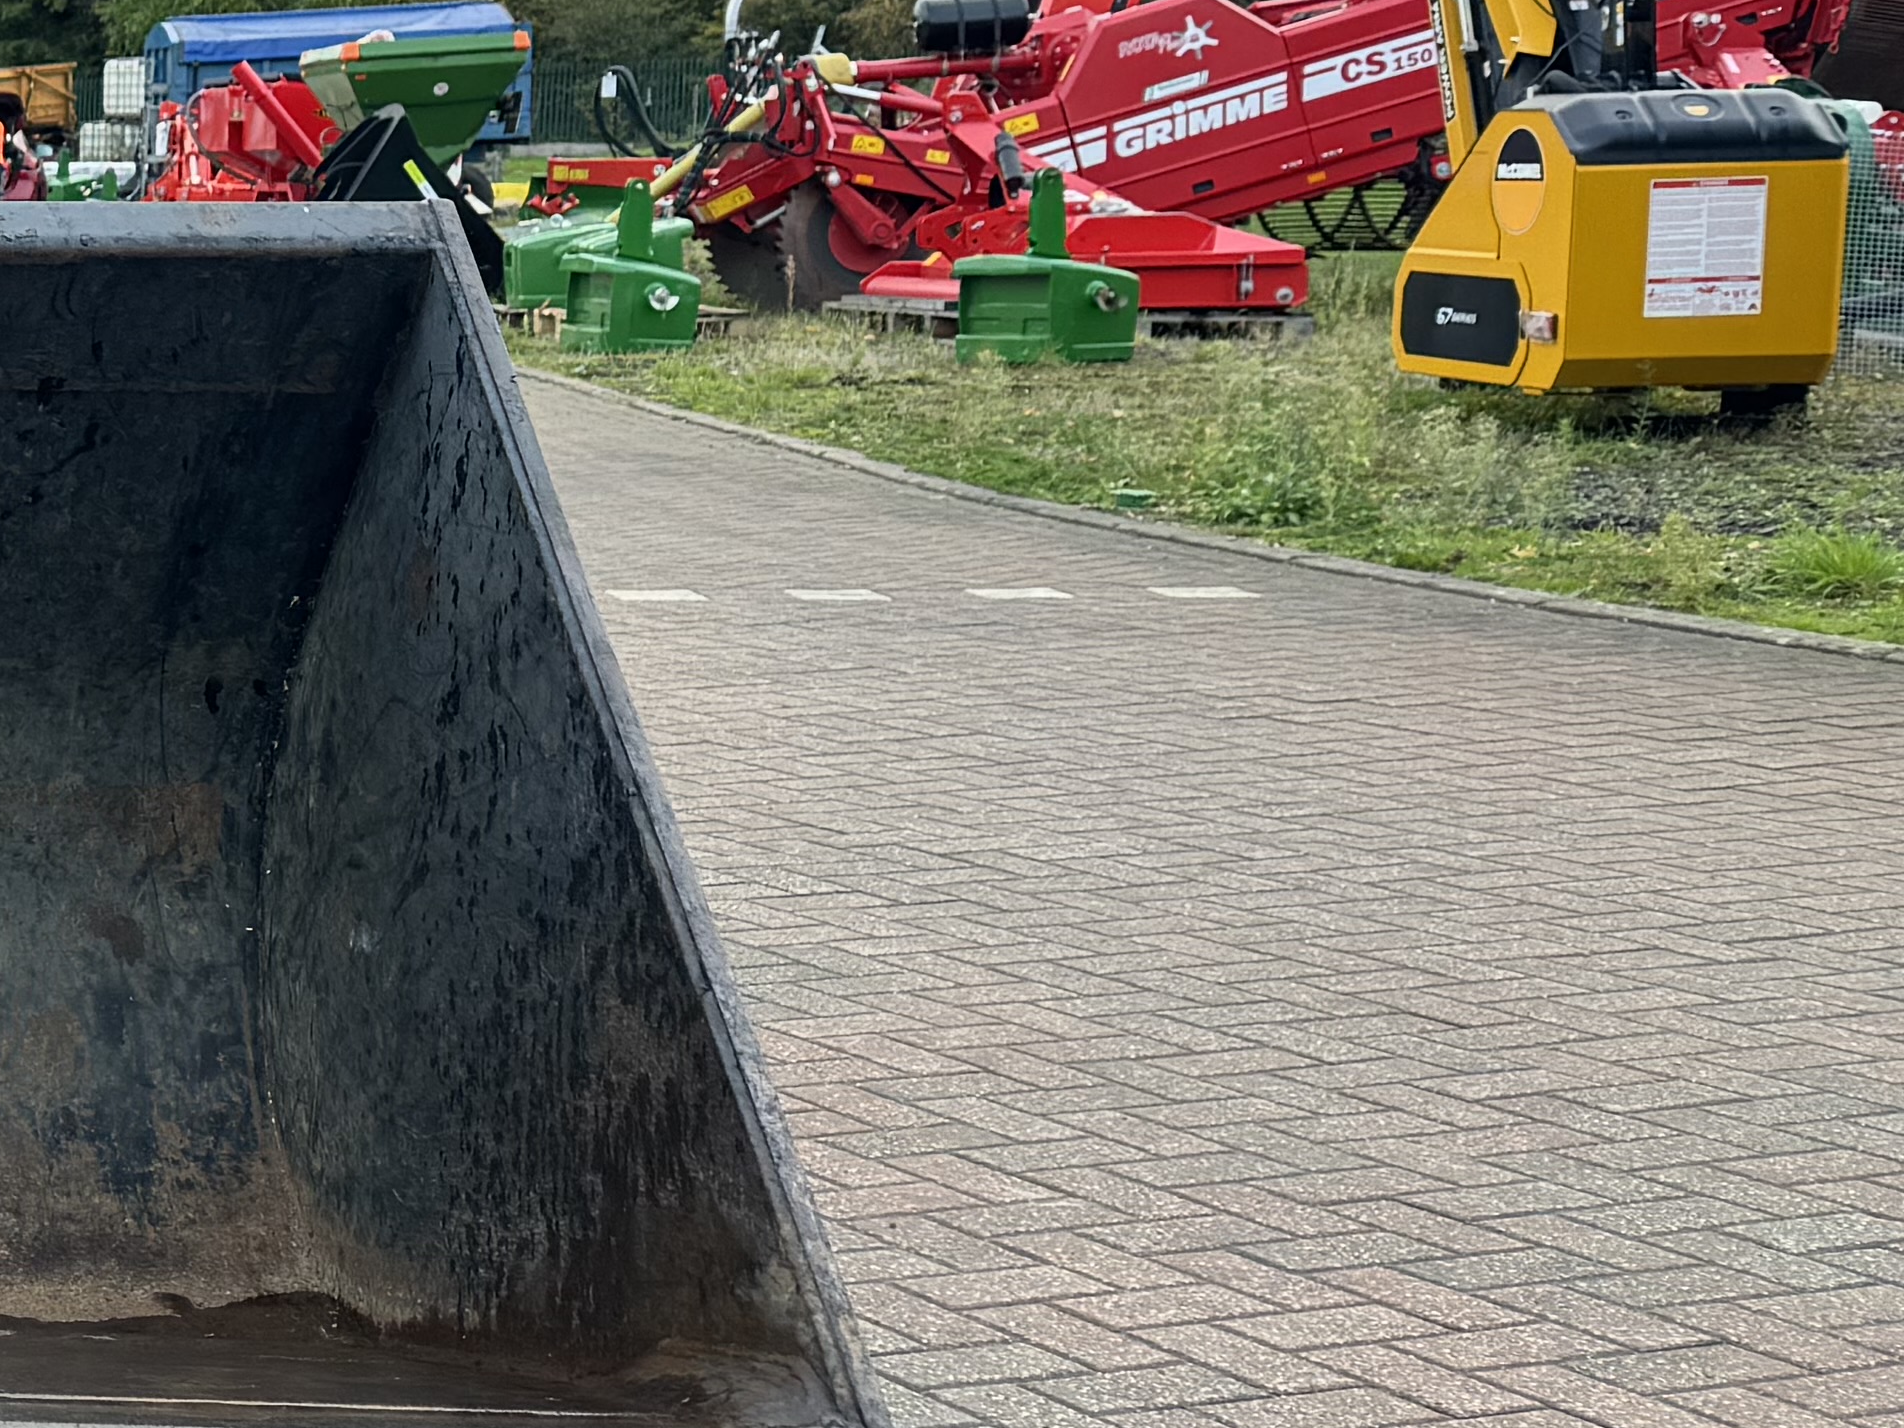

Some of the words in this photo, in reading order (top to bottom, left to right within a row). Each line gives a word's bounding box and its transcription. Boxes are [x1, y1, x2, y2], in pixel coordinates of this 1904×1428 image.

[1341, 51, 1388, 83] CS
[1392, 48, 1433, 72] 150
[1436, 306, 1454, 325] 67
